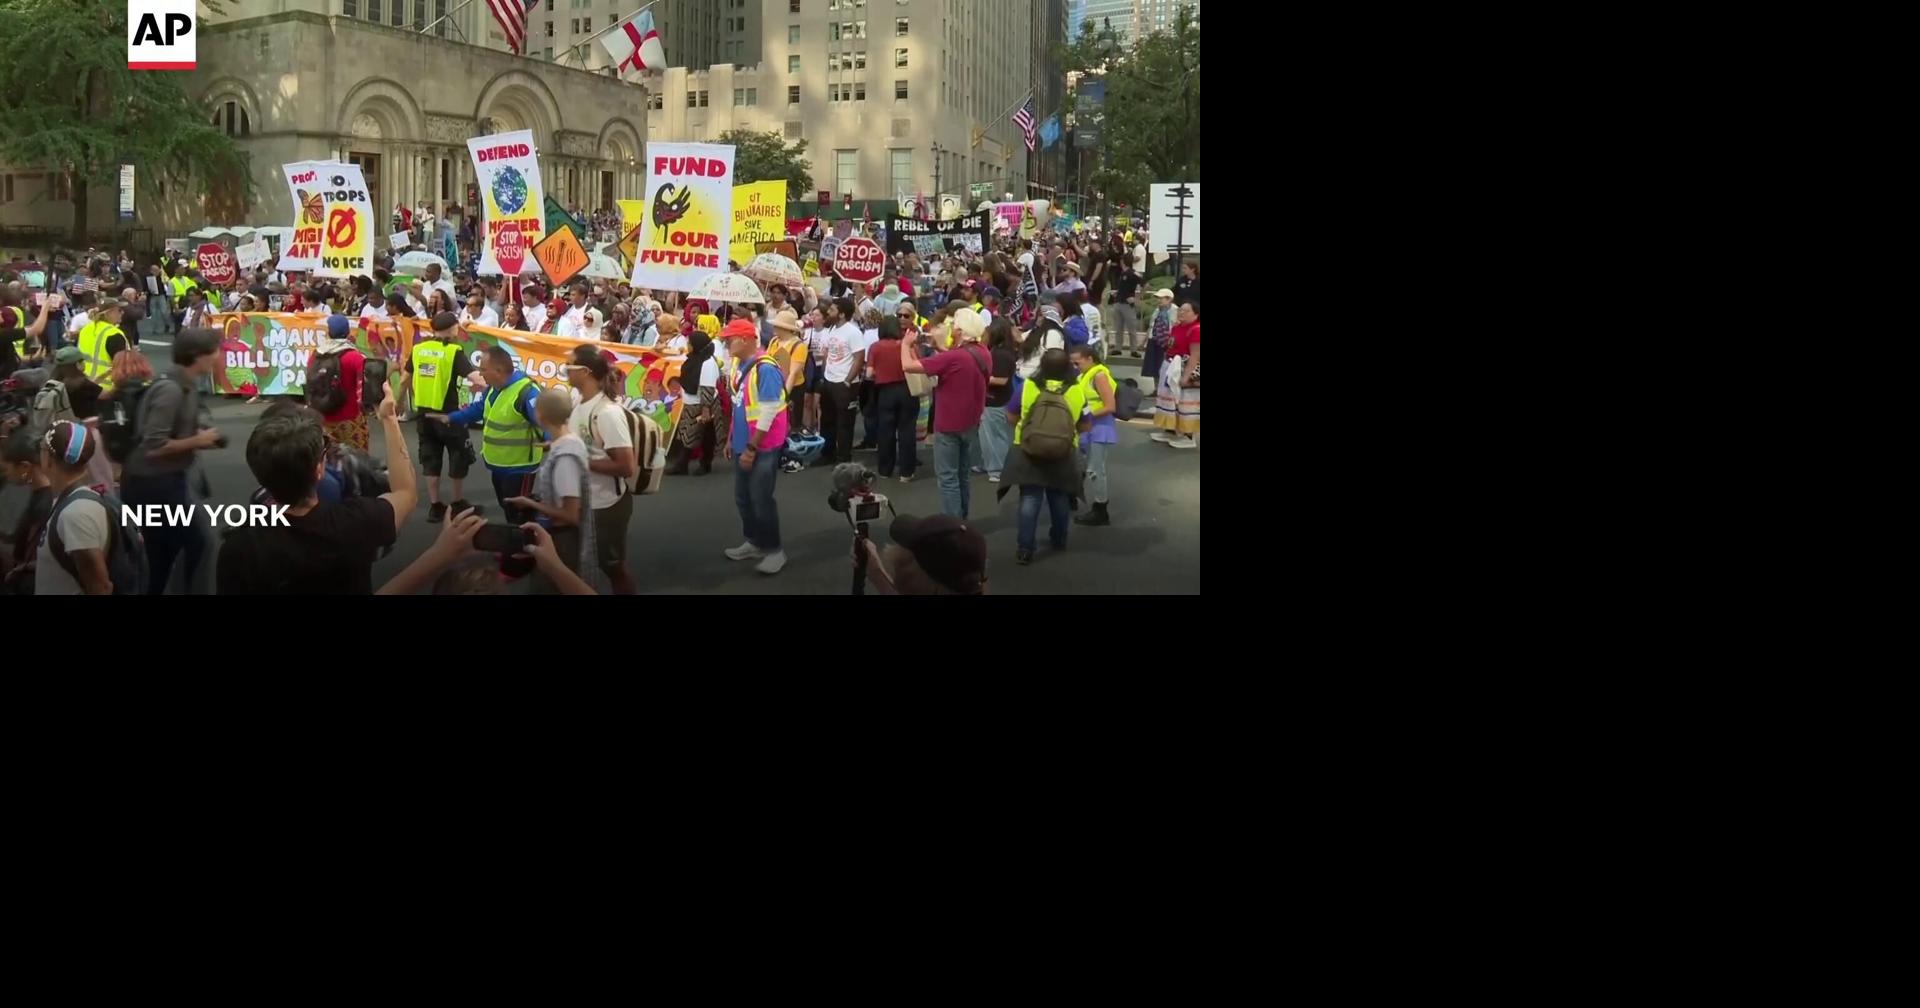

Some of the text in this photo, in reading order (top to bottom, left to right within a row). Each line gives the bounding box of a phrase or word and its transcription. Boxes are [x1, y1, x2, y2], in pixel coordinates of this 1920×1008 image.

[654, 157, 727, 177] FUND
[894, 219, 930, 232] REBEL
[936, 220, 955, 232] OR
[962, 215, 982, 229] DIE
[500, 231, 519, 244] STOP
[670, 231, 719, 249] OUR
[200, 252, 229, 269] STOP
[495, 245, 523, 259] FASCISM
[640, 250, 719, 268] FUTURE
[839, 245, 881, 261] STOP
[201, 266, 235, 277] FASCISM
[322, 257, 365, 269] NO ICE
[836, 259, 881, 273] FASCISM
[225, 349, 309, 368] BILLION
[282, 369, 307, 388] PA
